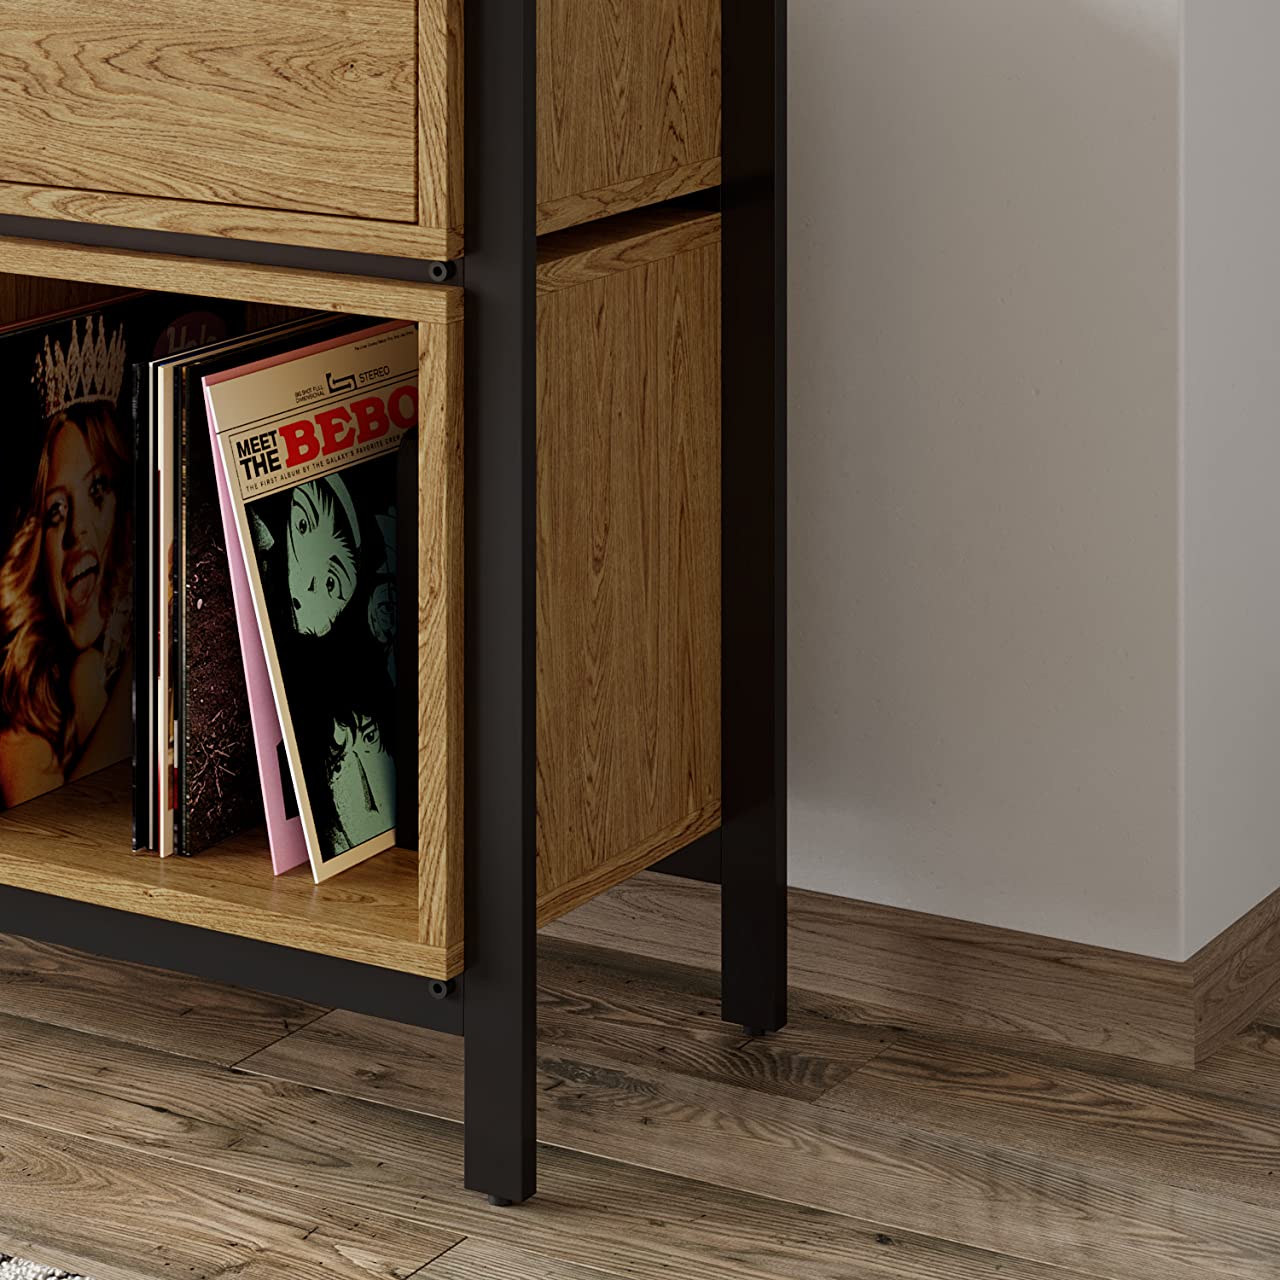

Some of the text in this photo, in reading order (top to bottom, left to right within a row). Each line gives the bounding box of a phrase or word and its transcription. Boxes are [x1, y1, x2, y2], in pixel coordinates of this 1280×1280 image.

[358, 365, 390, 383] STEREO
[278, 385, 418, 468] BEBO
[236, 429, 278, 458] MEET
[239, 448, 282, 480] THE
[246, 483, 259, 492] THE
[260, 476, 278, 487] FIRST
[280, 469, 301, 480] ALBUM
[312, 461, 324, 469] THE
[325, 450, 354, 464] GALAXY'S
[356, 439, 383, 454] FAVORITE
